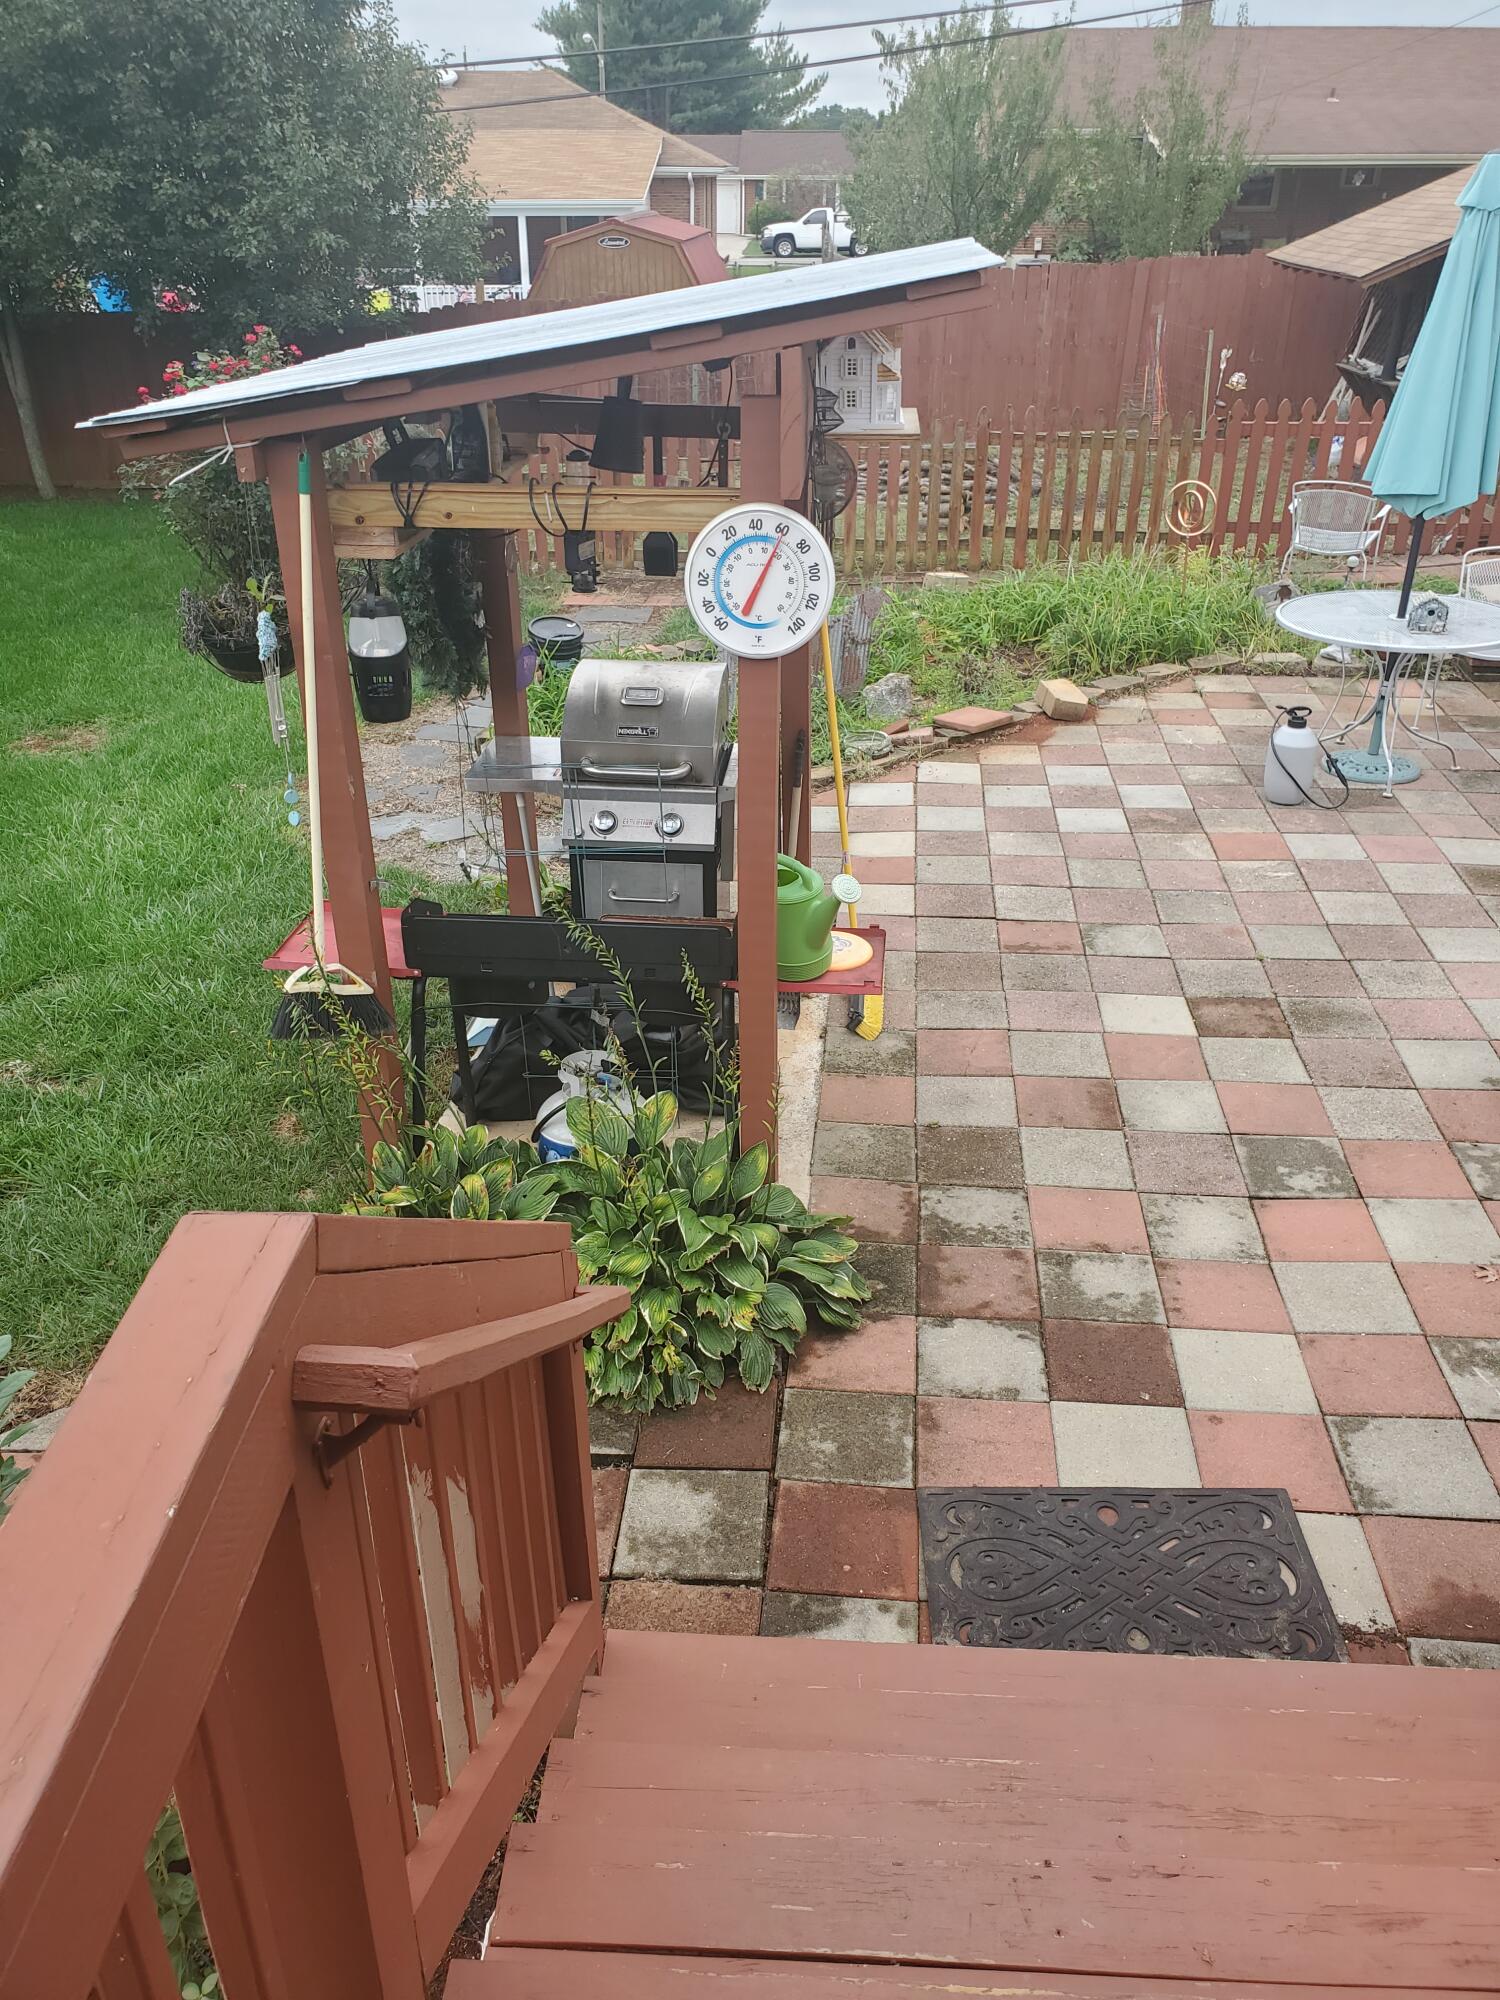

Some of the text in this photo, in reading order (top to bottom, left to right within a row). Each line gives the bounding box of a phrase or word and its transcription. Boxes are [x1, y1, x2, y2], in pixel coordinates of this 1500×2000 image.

[748, 518, 763, 531] 40
[775, 522, 790, 537] 60
[721, 525, 737, 541] 20
[705, 547, 717, 558] 0
[796, 538, 811, 555] 80
[774, 552, 783, 561] 20
[697, 568, 710, 587] -20
[808, 562, 821, 582] 100
[785, 591, 793, 600] 50
[805, 593, 820, 611] 120
[702, 596, 716, 614] -40
[777, 604, 785, 612] 60
[713, 615, 729, 631] -60
[787, 617, 806, 635] 140
